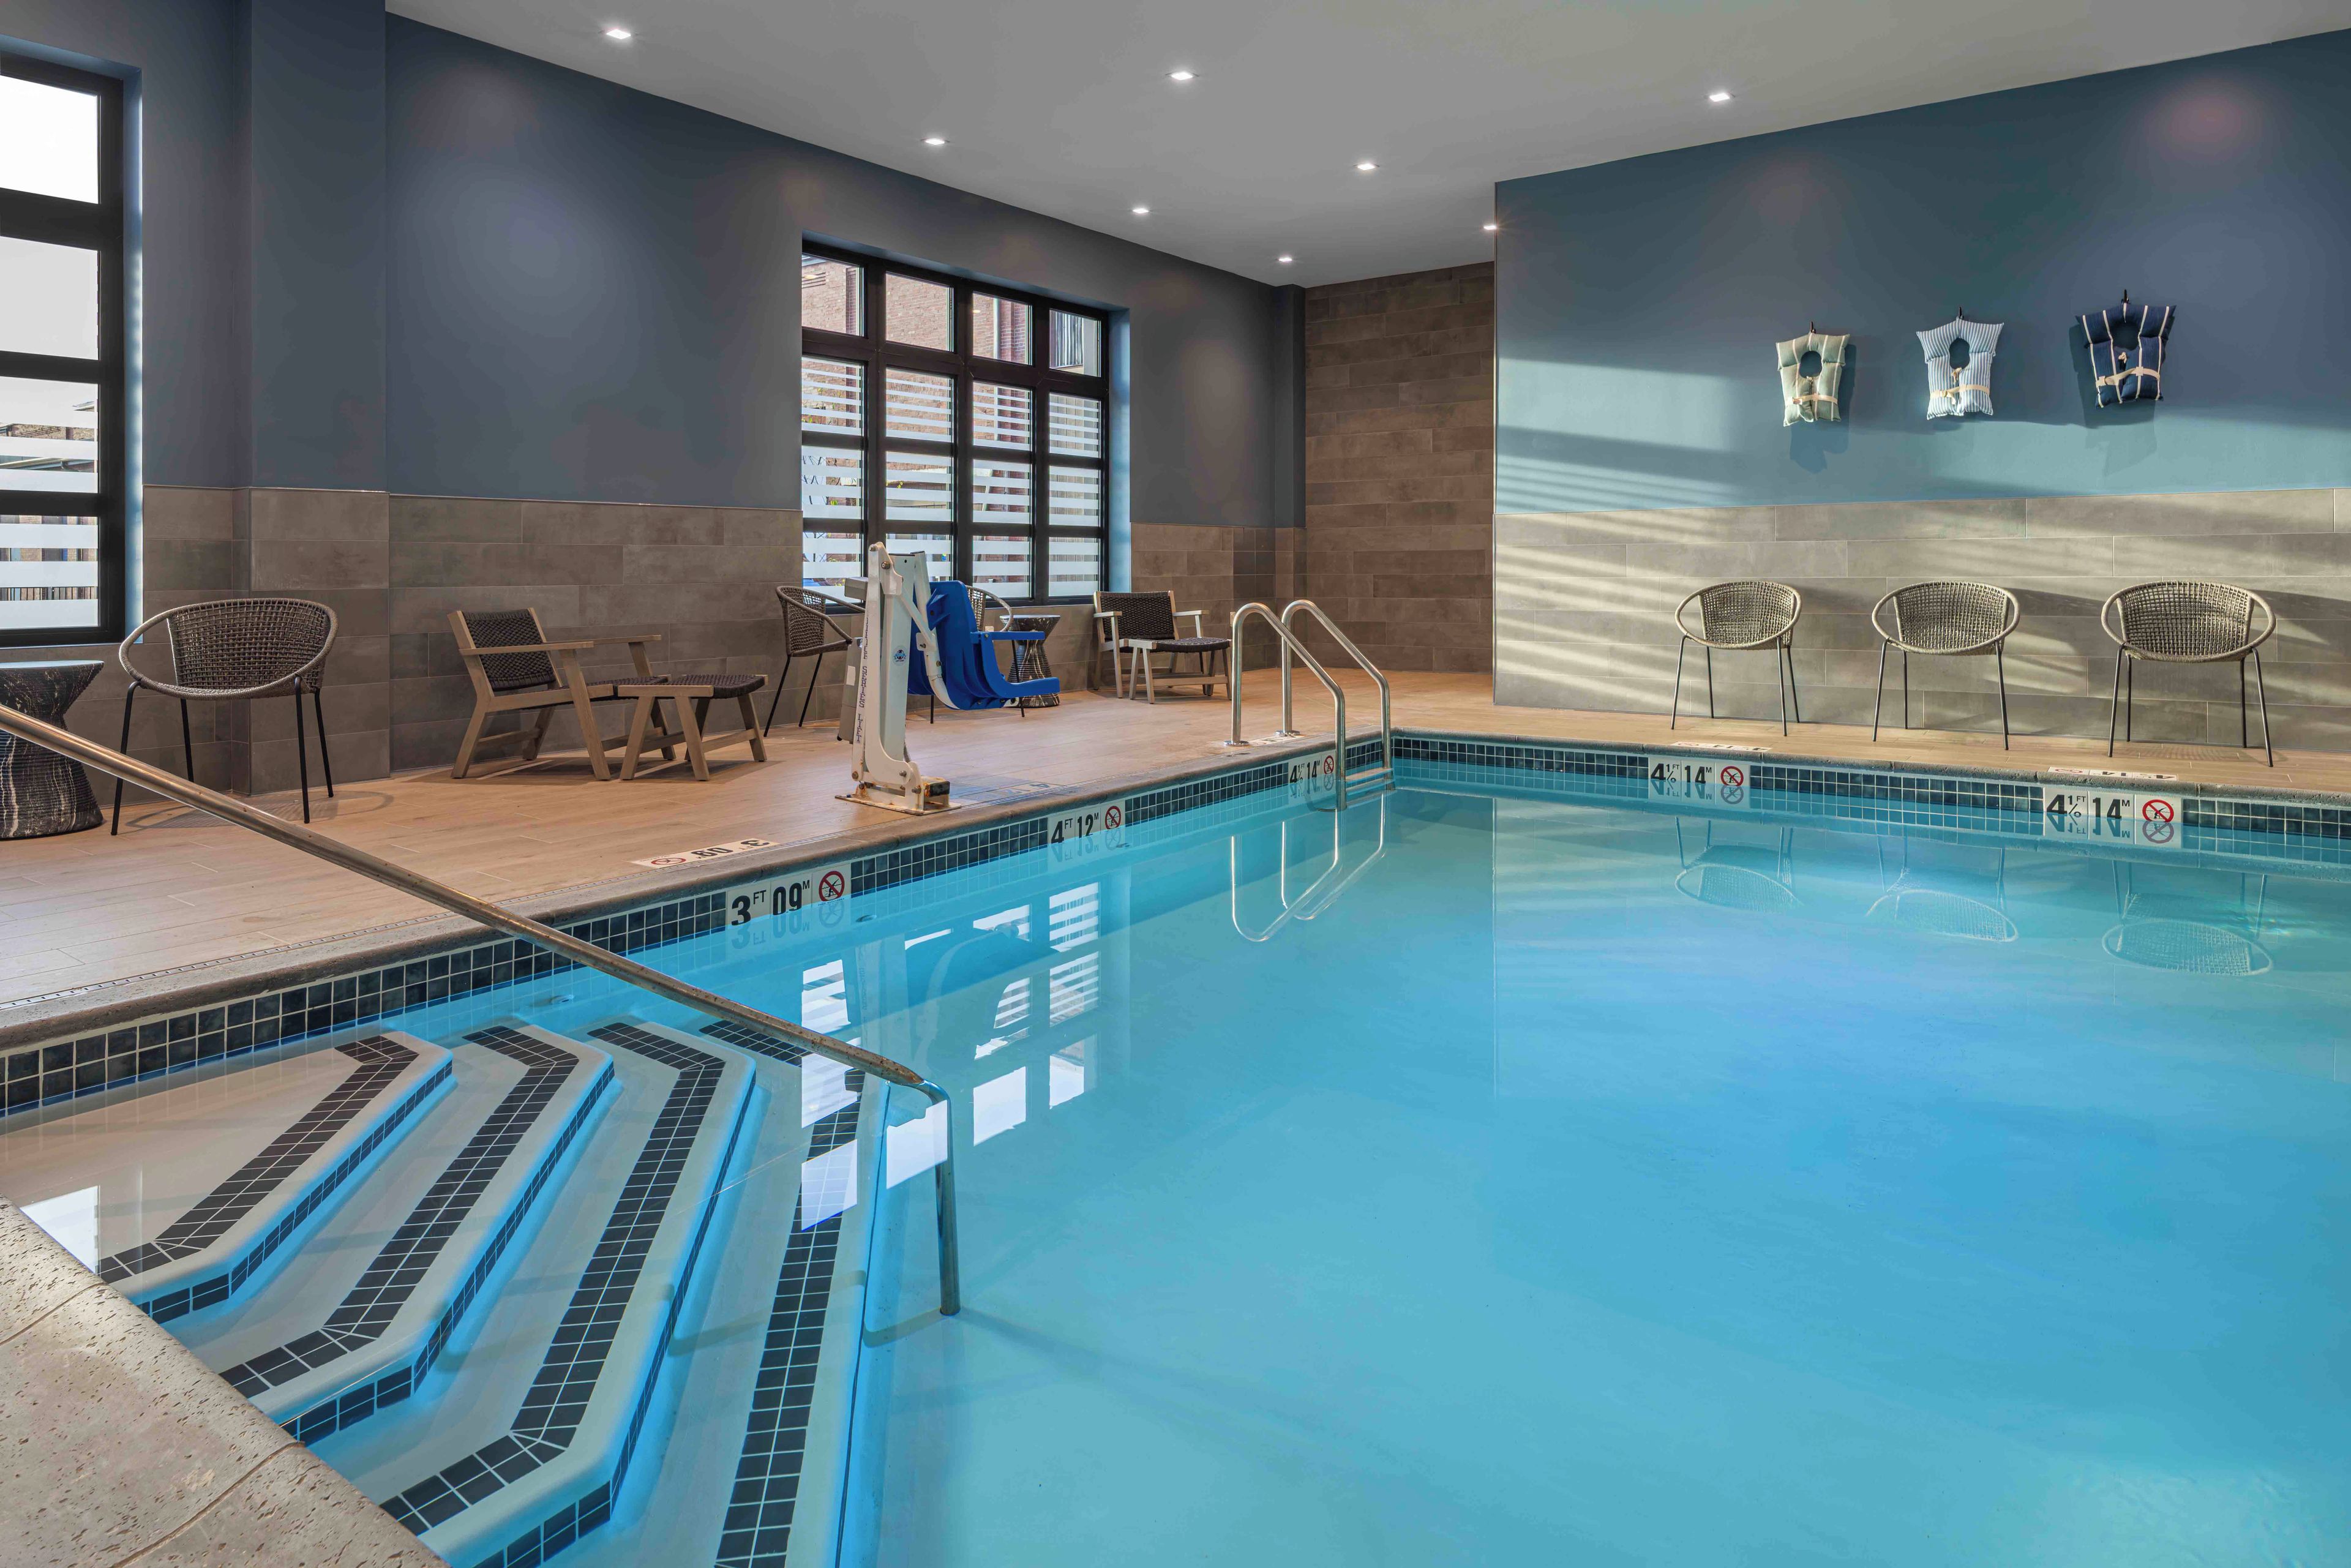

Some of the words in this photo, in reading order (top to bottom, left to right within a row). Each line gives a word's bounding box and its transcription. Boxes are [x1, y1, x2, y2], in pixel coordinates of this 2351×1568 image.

[1290, 765, 1297, 783] 4
[1307, 761, 1317, 779] 14
[1651, 763, 1666, 780] 4
[1684, 765, 1706, 784] 14
[2047, 794, 2068, 814] 4
[2093, 797, 2122, 819] 14
[1051, 820, 1064, 844] 4
[1065, 818, 1073, 830] FT
[1078, 814, 1093, 838] 12
[731, 895, 751, 926] 3
[753, 890, 767, 904] FT
[803, 880, 810, 890] M
